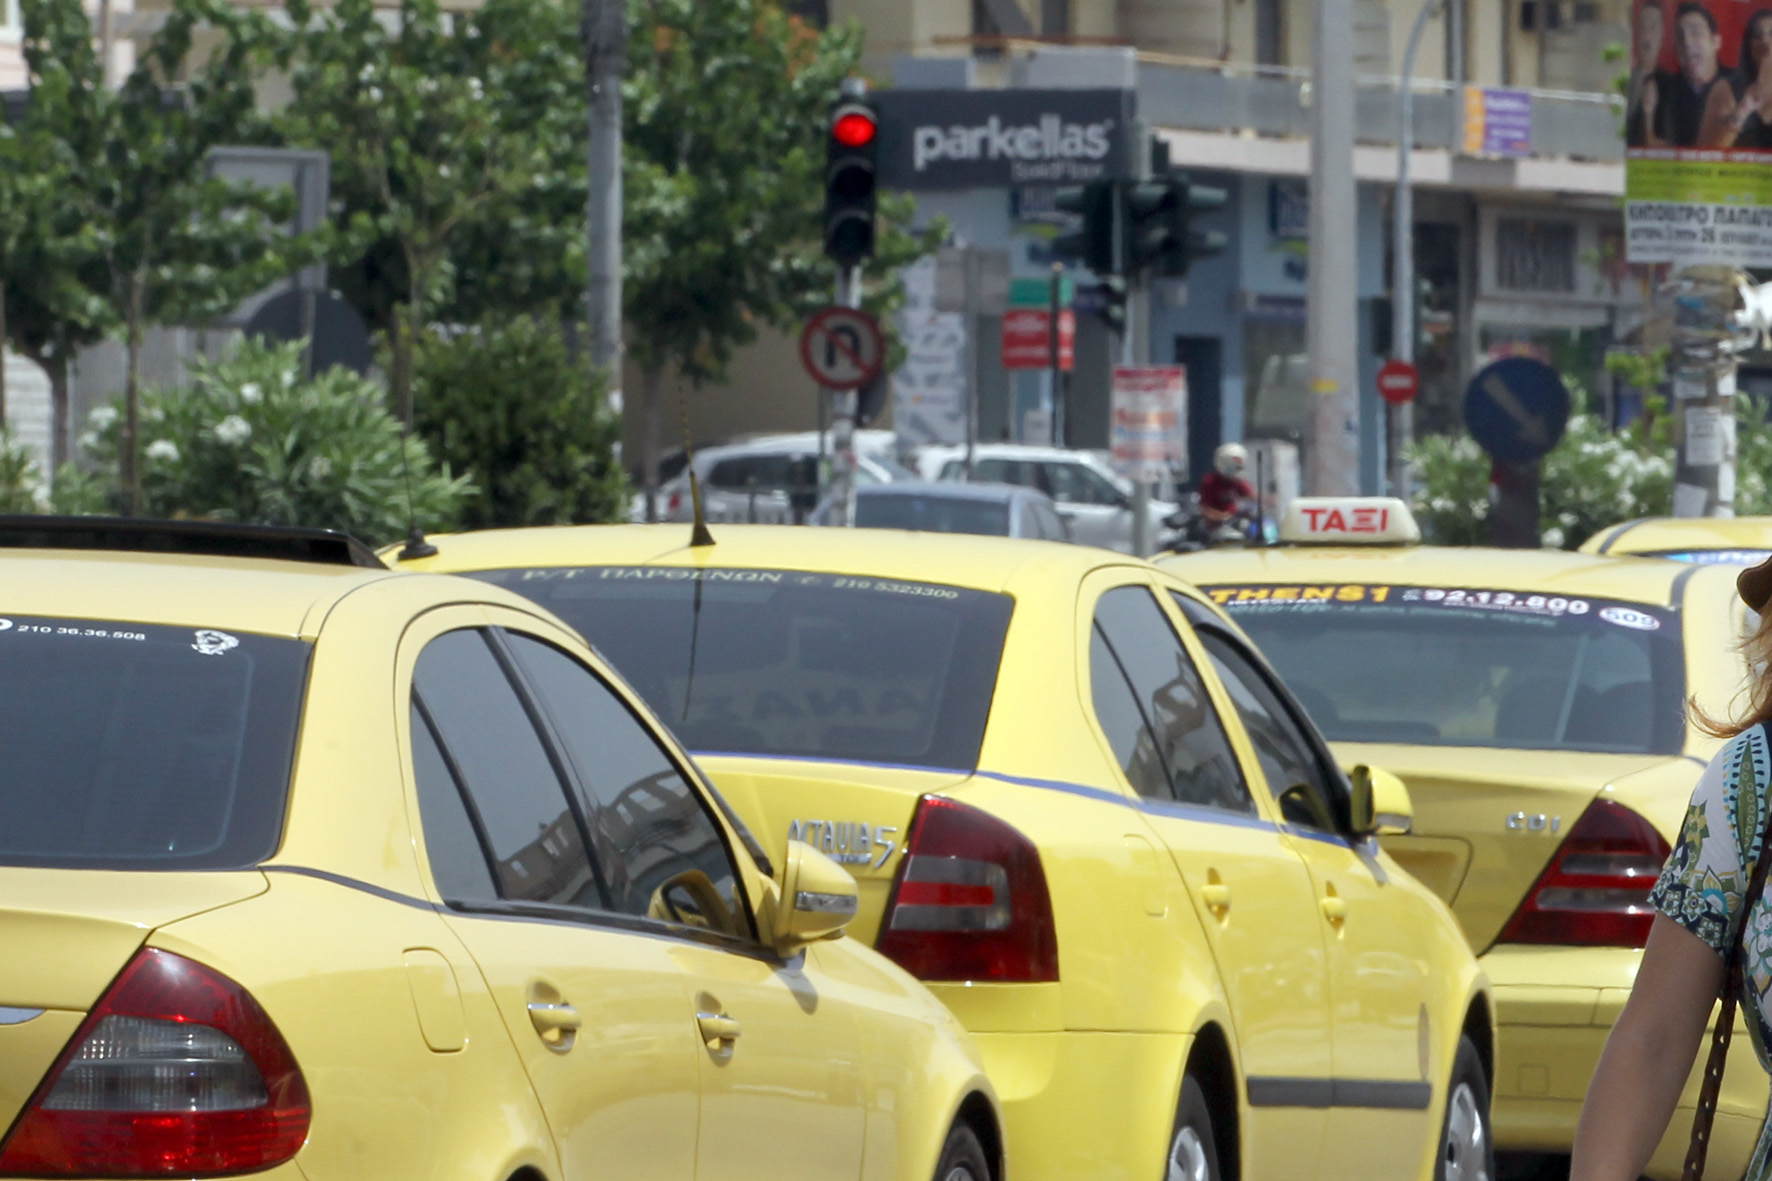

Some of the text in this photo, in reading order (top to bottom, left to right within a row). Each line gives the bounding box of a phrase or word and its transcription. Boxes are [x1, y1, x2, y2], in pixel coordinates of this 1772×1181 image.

[913, 114, 1110, 172] parkellas
[1302, 508, 1389, 532] ΤΑΞΙ
[1207, 585, 1390, 604] THENS1
[17, 624, 146, 641] 210 36.36.508
[1506, 811, 1561, 833] CDI
